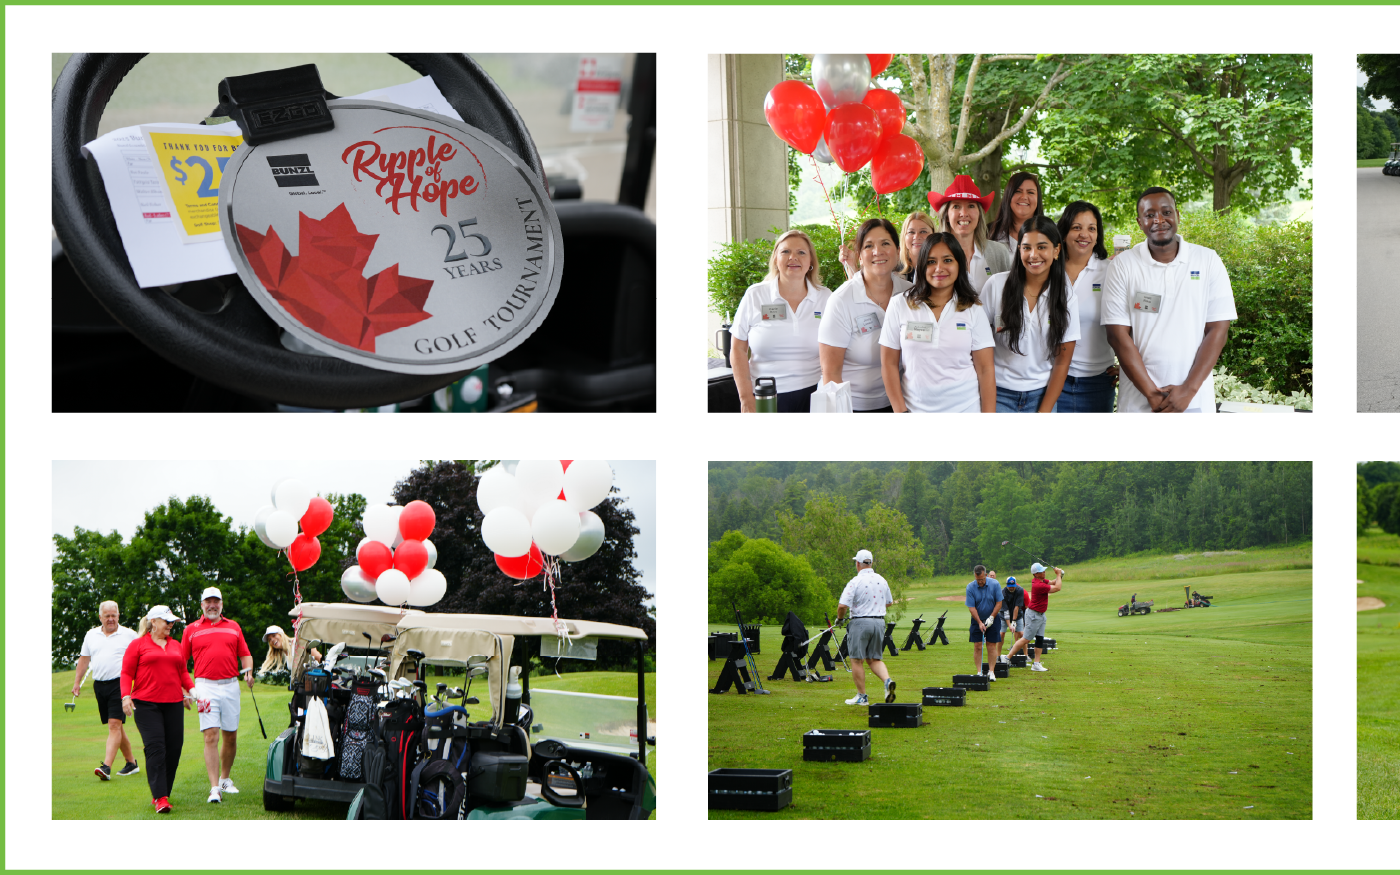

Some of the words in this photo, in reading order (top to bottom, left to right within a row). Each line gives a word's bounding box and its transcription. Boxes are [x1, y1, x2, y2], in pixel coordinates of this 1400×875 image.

[163, 142, 190, 150] THANK
[342, 135, 457, 186] Ripple
[272, 167, 314, 175] BUNZL
[425, 161, 442, 183] of
[375, 172, 479, 217] Hope
[431, 217, 492, 262] 25
[414, 327, 478, 355] GOLF
[482, 198, 544, 331] TOURNAMENT
[443, 258, 503, 279] YEARS
